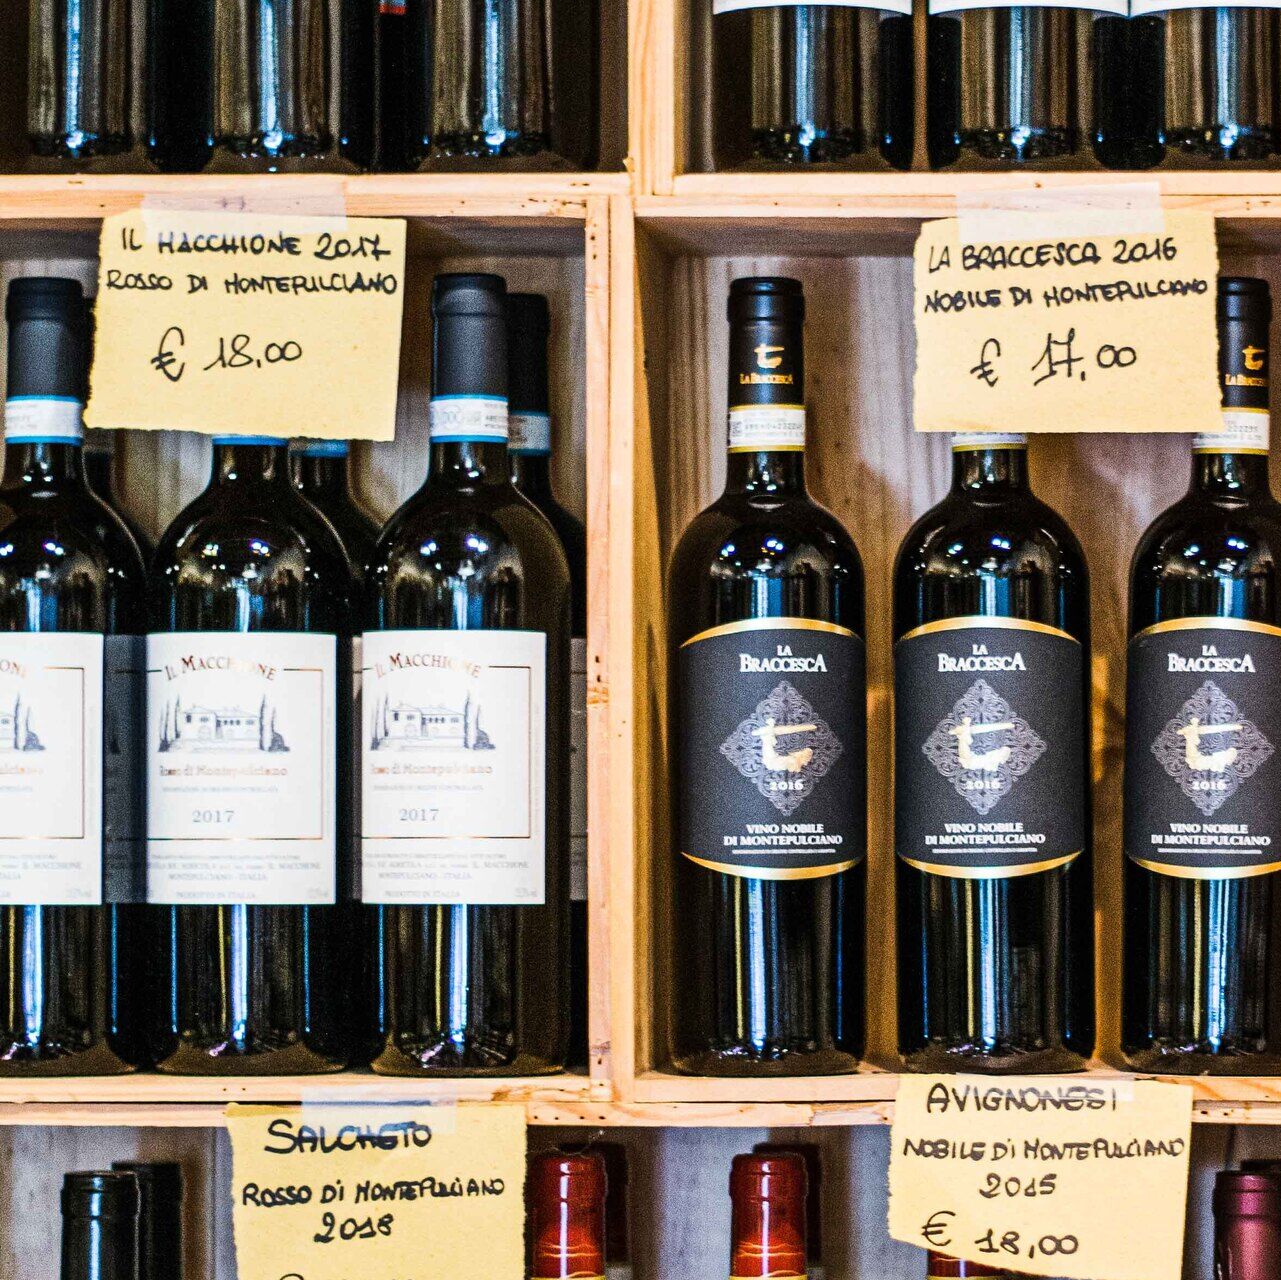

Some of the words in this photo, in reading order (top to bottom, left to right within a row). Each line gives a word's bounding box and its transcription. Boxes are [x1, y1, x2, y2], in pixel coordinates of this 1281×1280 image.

[121, 227, 142, 251] IL
[314, 232, 392, 261] 2017
[929, 245, 951, 274] LA
[962, 242, 1102, 271] BRACCESCA
[1111, 237, 1178, 265] 2016
[106, 269, 172, 290] ROSSO
[187, 274, 209, 295] DI
[924, 288, 1002, 313] NOBILE
[1011, 286, 1033, 307] DI
[739, 653, 828, 673] BRACCESCA
[777, 645, 793, 656] LA
[769, 781, 804, 791] 2016
[192, 809, 235, 824] 2017
[746, 824, 780, 834] VINO
[781, 824, 825, 834] NOBILE
[724, 836, 738, 846] DI
[740, 835, 843, 846] MONTEPULCIANO
[927, 1082, 1118, 1114] AVIGNONESI
[978, 1172, 1058, 1199] 2015
[313, 1211, 394, 1244] 2018
[921, 1210, 957, 1247] €
[974, 1228, 1079, 1258] 18,00
